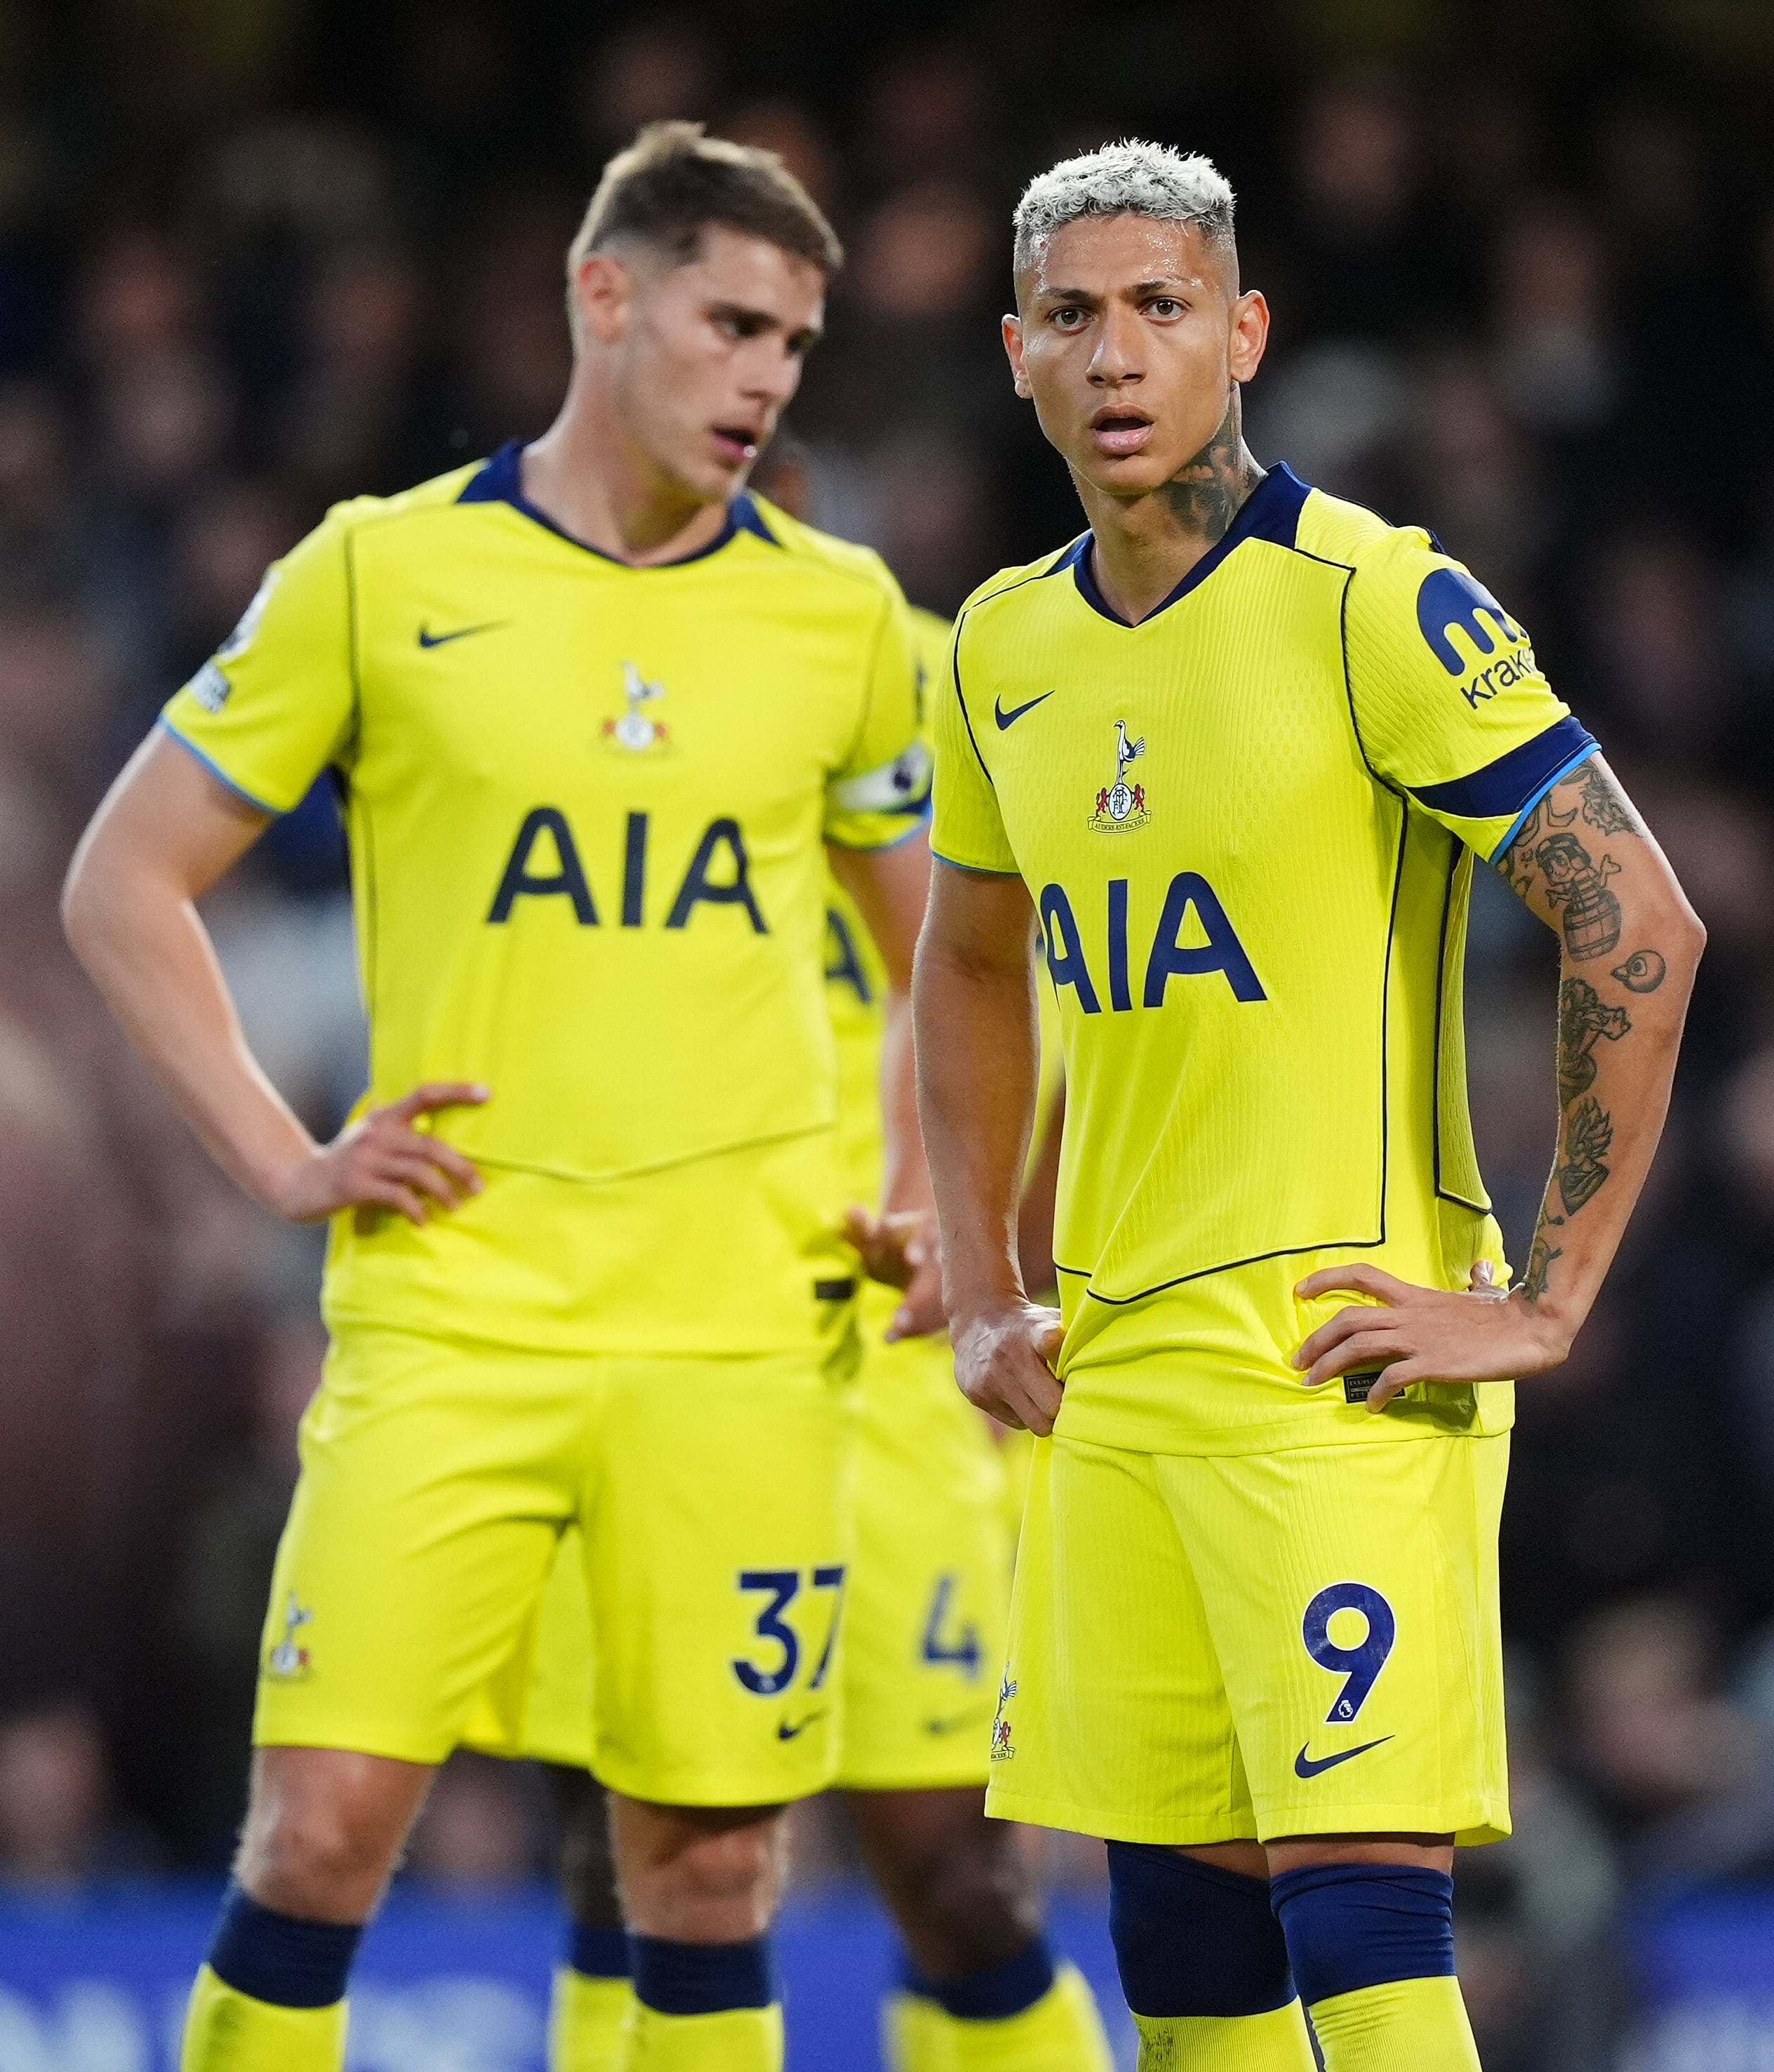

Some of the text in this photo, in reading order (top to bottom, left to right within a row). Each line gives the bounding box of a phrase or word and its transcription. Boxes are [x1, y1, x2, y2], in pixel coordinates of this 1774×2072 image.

[486, 806, 770, 935] AIA
[1037, 871, 1268, 1014] AIA
[731, 1565, 846, 1697] 37
[921, 1569, 982, 1685] 4
[1302, 1581, 1396, 1725] 9
